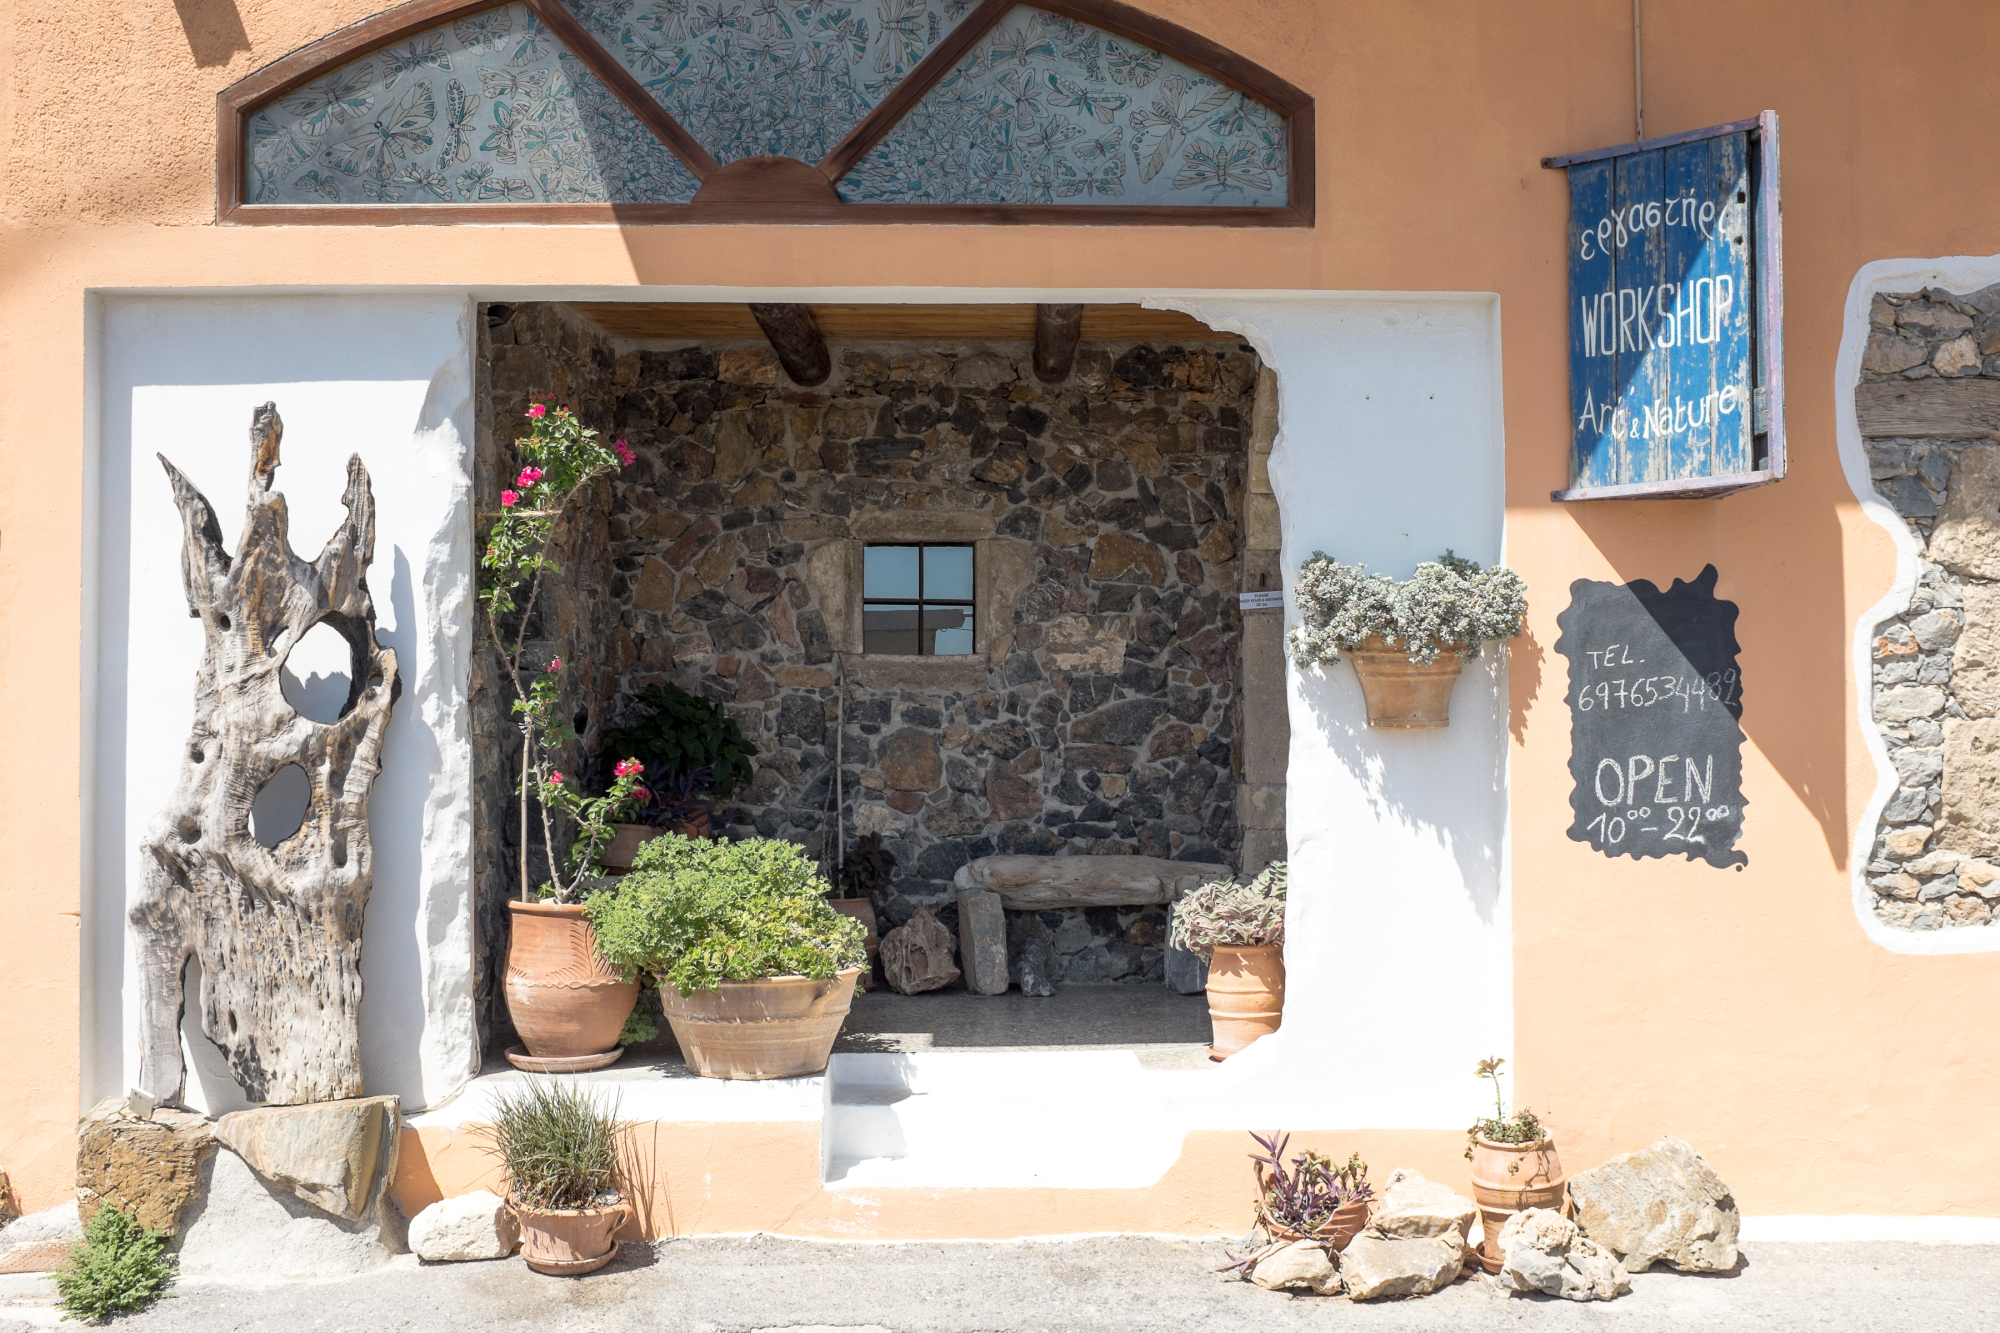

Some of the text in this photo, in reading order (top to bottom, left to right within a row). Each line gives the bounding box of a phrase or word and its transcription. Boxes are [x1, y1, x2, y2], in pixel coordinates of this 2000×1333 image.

[1582, 274, 1733, 358] WORKSHOP
[1629, 417, 1641, 440] &
[1642, 384, 1737, 440] Nature
[1586, 644, 1645, 670] TEL.
[1594, 754, 1714, 807] OPEN
